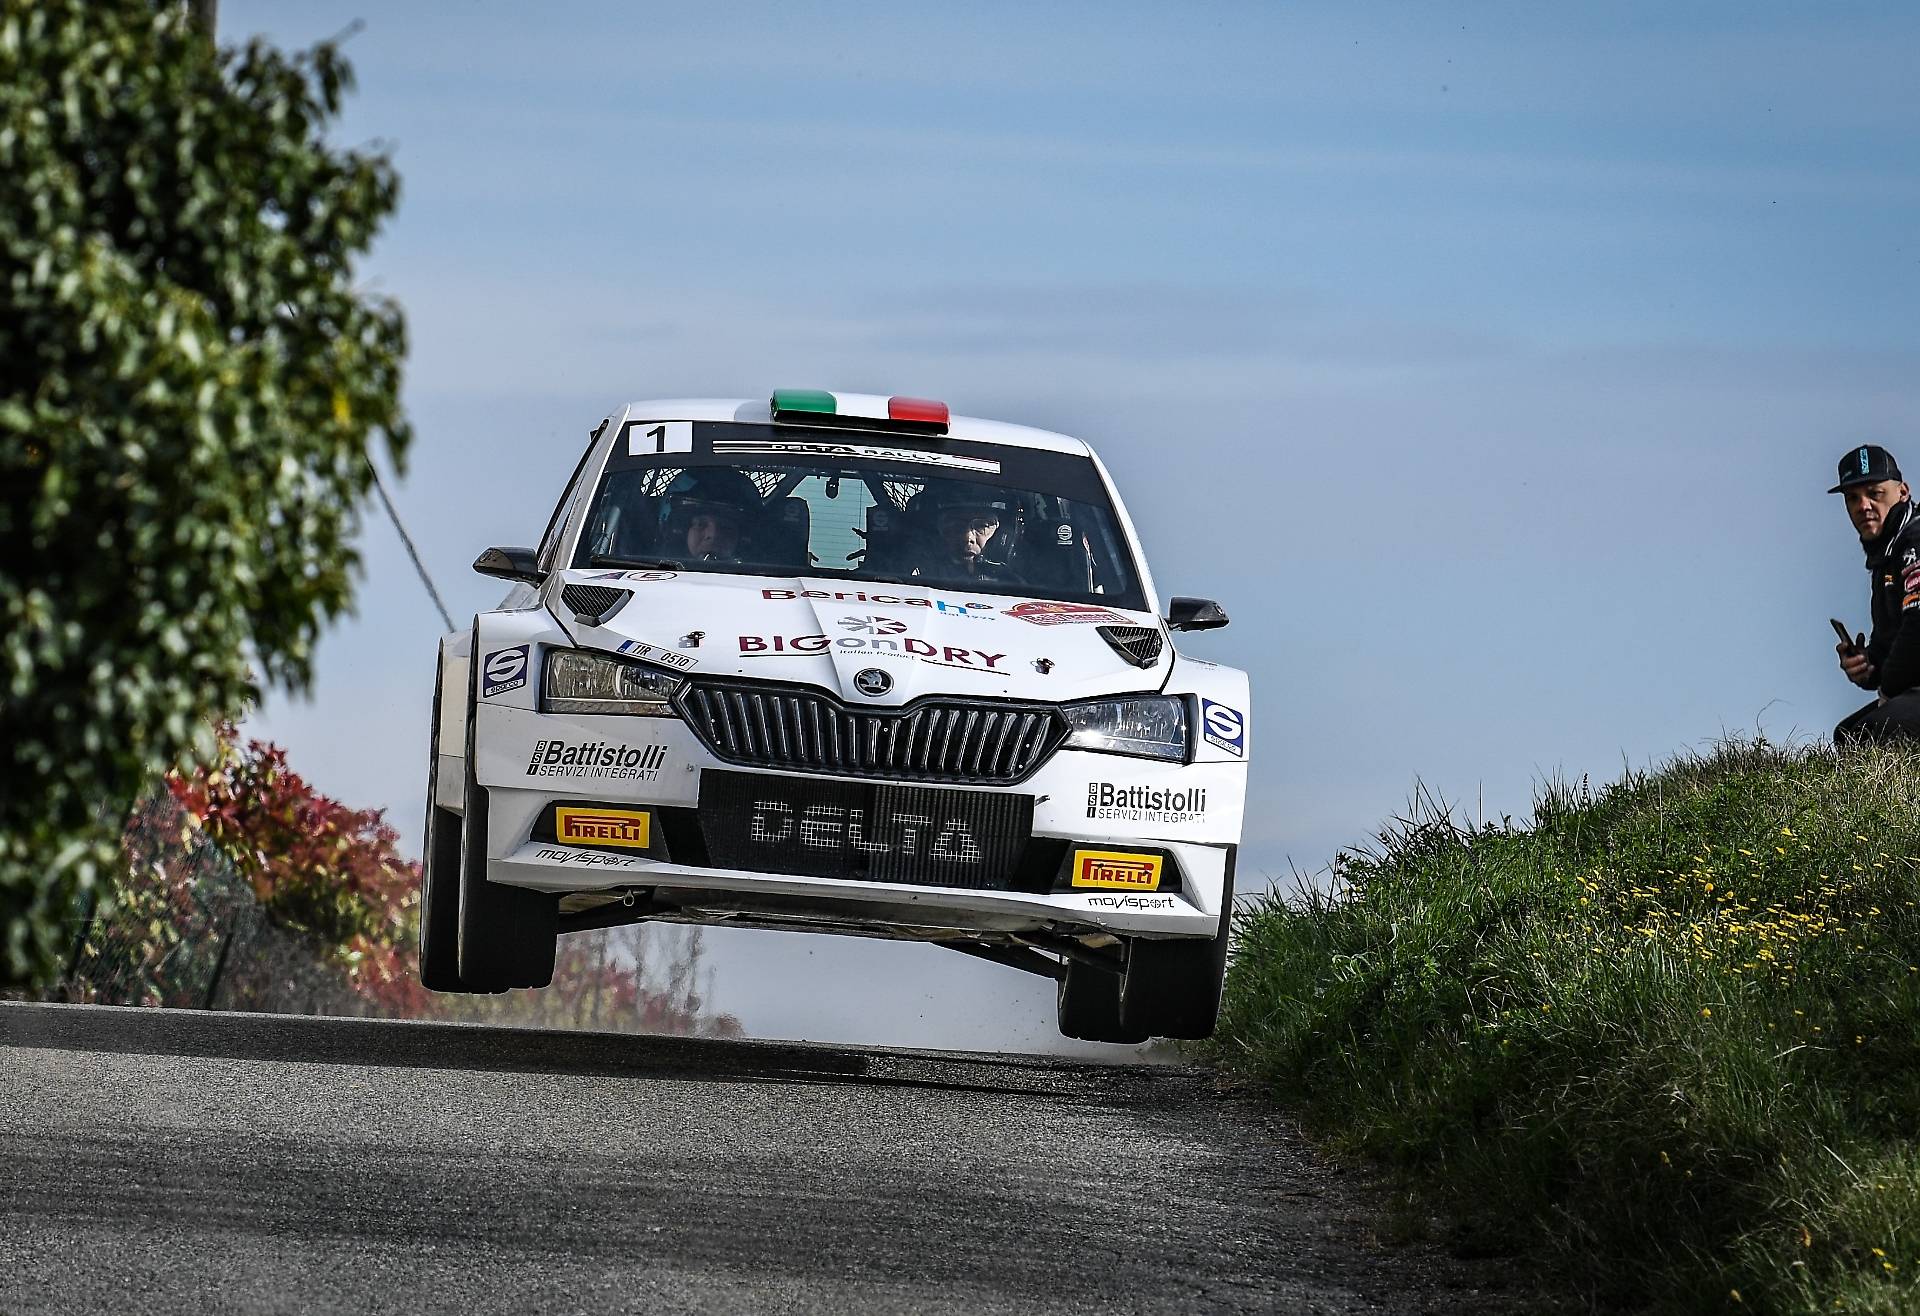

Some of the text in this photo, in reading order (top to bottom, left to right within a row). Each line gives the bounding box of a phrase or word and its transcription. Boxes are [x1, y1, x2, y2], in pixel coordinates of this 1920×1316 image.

[646, 425, 666, 453] 1
[660, 652, 690, 668] 0510
[543, 740, 668, 770] Battistolli
[538, 765, 659, 782] SERVIZI INTEGRATI
[1099, 782, 1207, 812] Battistolli
[564, 814, 641, 841] PIRELLI
[1097, 808, 1206, 824] SERVIZI INTEGRATI
[750, 799, 984, 864] DELTA
[535, 849, 637, 867] movisport
[1081, 857, 1155, 885] PIRELLI
[1087, 894, 1175, 911] movisport
